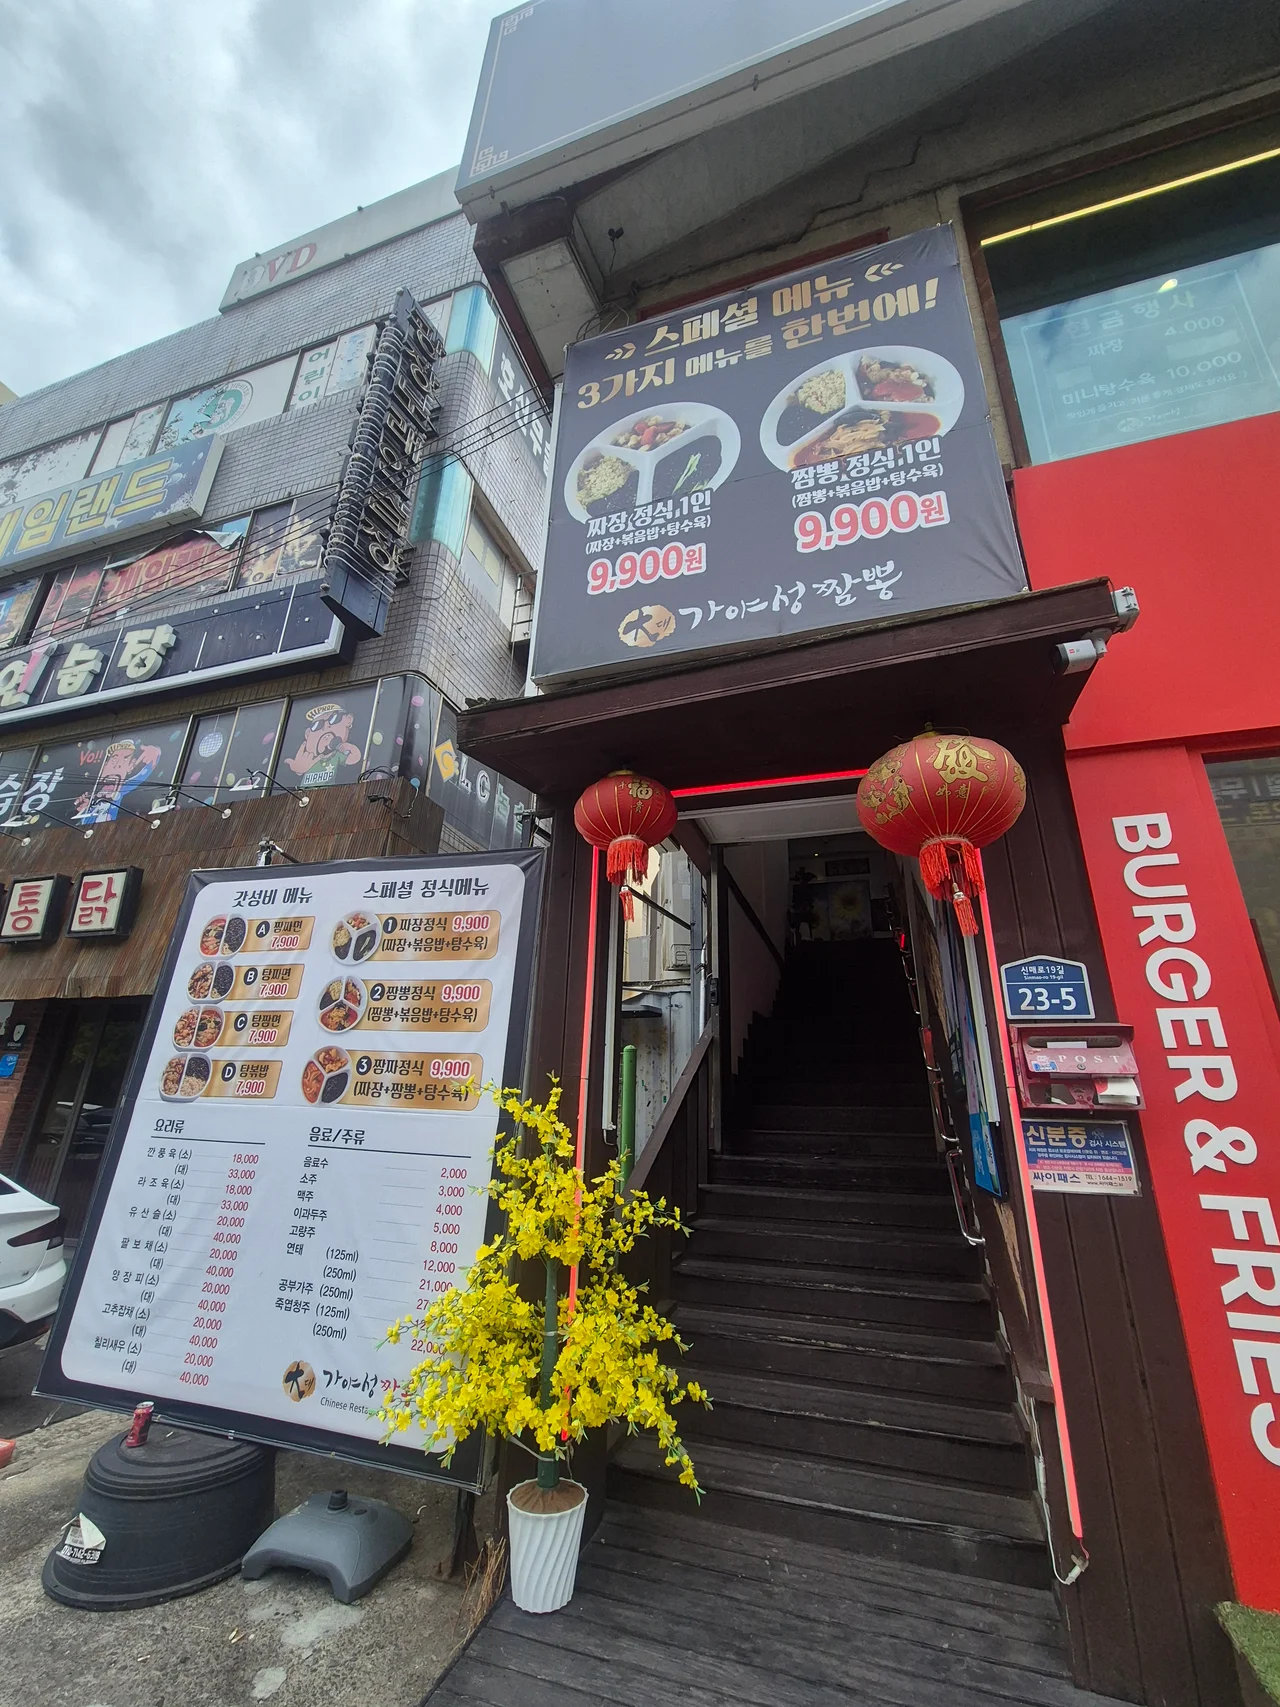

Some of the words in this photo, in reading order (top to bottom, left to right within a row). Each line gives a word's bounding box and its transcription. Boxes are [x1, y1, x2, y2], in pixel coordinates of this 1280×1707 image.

[644, 297, 758, 356] 스페셜
[772, 275, 854, 317] 메뉴
[577, 358, 675, 409] 3가지
[685, 334, 773, 377] 메뉴를
[781, 277, 939, 349] 한번에!
[791, 461, 840, 490] 짬뽕
[846, 448, 895, 478] 정식
[791, 463, 944, 508] (짬뽕+볶음밥+탕수육)
[587, 511, 628, 538] 짜장
[632, 499, 674, 528] 정식
[797, 494, 946, 550] 9,900원
[585, 515, 711, 554] (짜장+볶음밥+탕수육)
[589, 544, 704, 593] 9,900원
[812, 560, 903, 607] 짬뽕
[79, 749, 103, 766] Yo!!
[304, 771, 334, 784] HIPHOP
[232, 888, 278, 908] 갓성비
[282, 887, 313, 904] 메뉴
[363, 880, 413, 899] 스페셜
[420, 877, 489, 898] 정식메뉴
[398, 917, 447, 932] 짜장정식
[452, 915, 490, 931] 9,900
[271, 935, 299, 949] 7,900
[381, 936, 488, 952] (짜장+볶음밥+탕수육)
[261, 968, 291, 981] 탕짜면
[1020, 965, 1065, 975] 신매로19길
[259, 983, 288, 997] 7,900
[385, 985, 435, 1001] 짬뽕정식
[441, 985, 480, 1001] 9,900
[1018, 987, 1077, 1011] 23-5
[1111, 812, 1239, 1104] BURGER
[1183, 1118, 1258, 1175] &
[367, 1007, 478, 1023] (짬뽕+볶음밥+탕수육)
[248, 1029, 277, 1044] 7,900
[1058, 1055, 1120, 1063] POST
[239, 1064, 269, 1078] 탕볶밥
[372, 1060, 424, 1076] 짬짜정식
[430, 1061, 471, 1078] 9,900
[235, 1080, 265, 1095] 7,900
[153, 1118, 185, 1134] 요리류
[309, 1126, 365, 1145] 음료/주류
[1026, 1125, 1087, 1148] 신분증
[1089, 1139, 1103, 1147] 검사
[1104, 1139, 1126, 1148] 시스템
[232, 1153, 259, 1165] 18,000
[303, 1156, 329, 1169] 음료수
[440, 1167, 467, 1180] 2,000
[174, 1164, 189, 1175] (대)
[227, 1168, 256, 1180] 33,000
[1033, 1172, 1081, 1183] 싸이패스
[1098, 1174, 1132, 1182] 1644-1519
[225, 1184, 252, 1196] 18,000
[299, 1173, 317, 1185] 소주
[438, 1185, 465, 1198] 3,000
[166, 1193, 181, 1206] (대)
[220, 1200, 249, 1212] 33,000
[297, 1190, 314, 1202] 맥주
[435, 1203, 463, 1216] 4,000
[216, 1216, 245, 1228] 20,000
[293, 1207, 328, 1221] 이과두주
[432, 1222, 461, 1235] 5,000
[158, 1225, 173, 1237] (대)
[212, 1232, 241, 1244] 40,000
[289, 1225, 316, 1238] 고량주
[430, 1241, 458, 1254] 8,000
[209, 1248, 238, 1261] 20,000
[286, 1242, 304, 1256] 연태
[325, 1246, 359, 1263] (125ml)
[422, 1259, 456, 1273] 12,000
[150, 1256, 164, 1270] (대)
[205, 1265, 234, 1278] 40,000
[323, 1265, 357, 1282] (250ml)
[201, 1282, 230, 1295] 20,000
[278, 1278, 314, 1295] 공부가주
[319, 1283, 354, 1301] (250ml)
[140, 1289, 155, 1304] (대)
[197, 1299, 226, 1313] 40,000
[274, 1297, 310, 1315] 죽엽청주
[315, 1302, 350, 1321] (125ml)
[192, 1316, 222, 1331] 20,000
[312, 1321, 347, 1340] (250ml)
[131, 1324, 147, 1338] (대)
[188, 1334, 218, 1349] 40,000
[183, 1352, 214, 1368] 20,000
[121, 1359, 137, 1374] (대)
[179, 1371, 209, 1387] 40,000
[320, 1396, 348, 1411] Chinese
